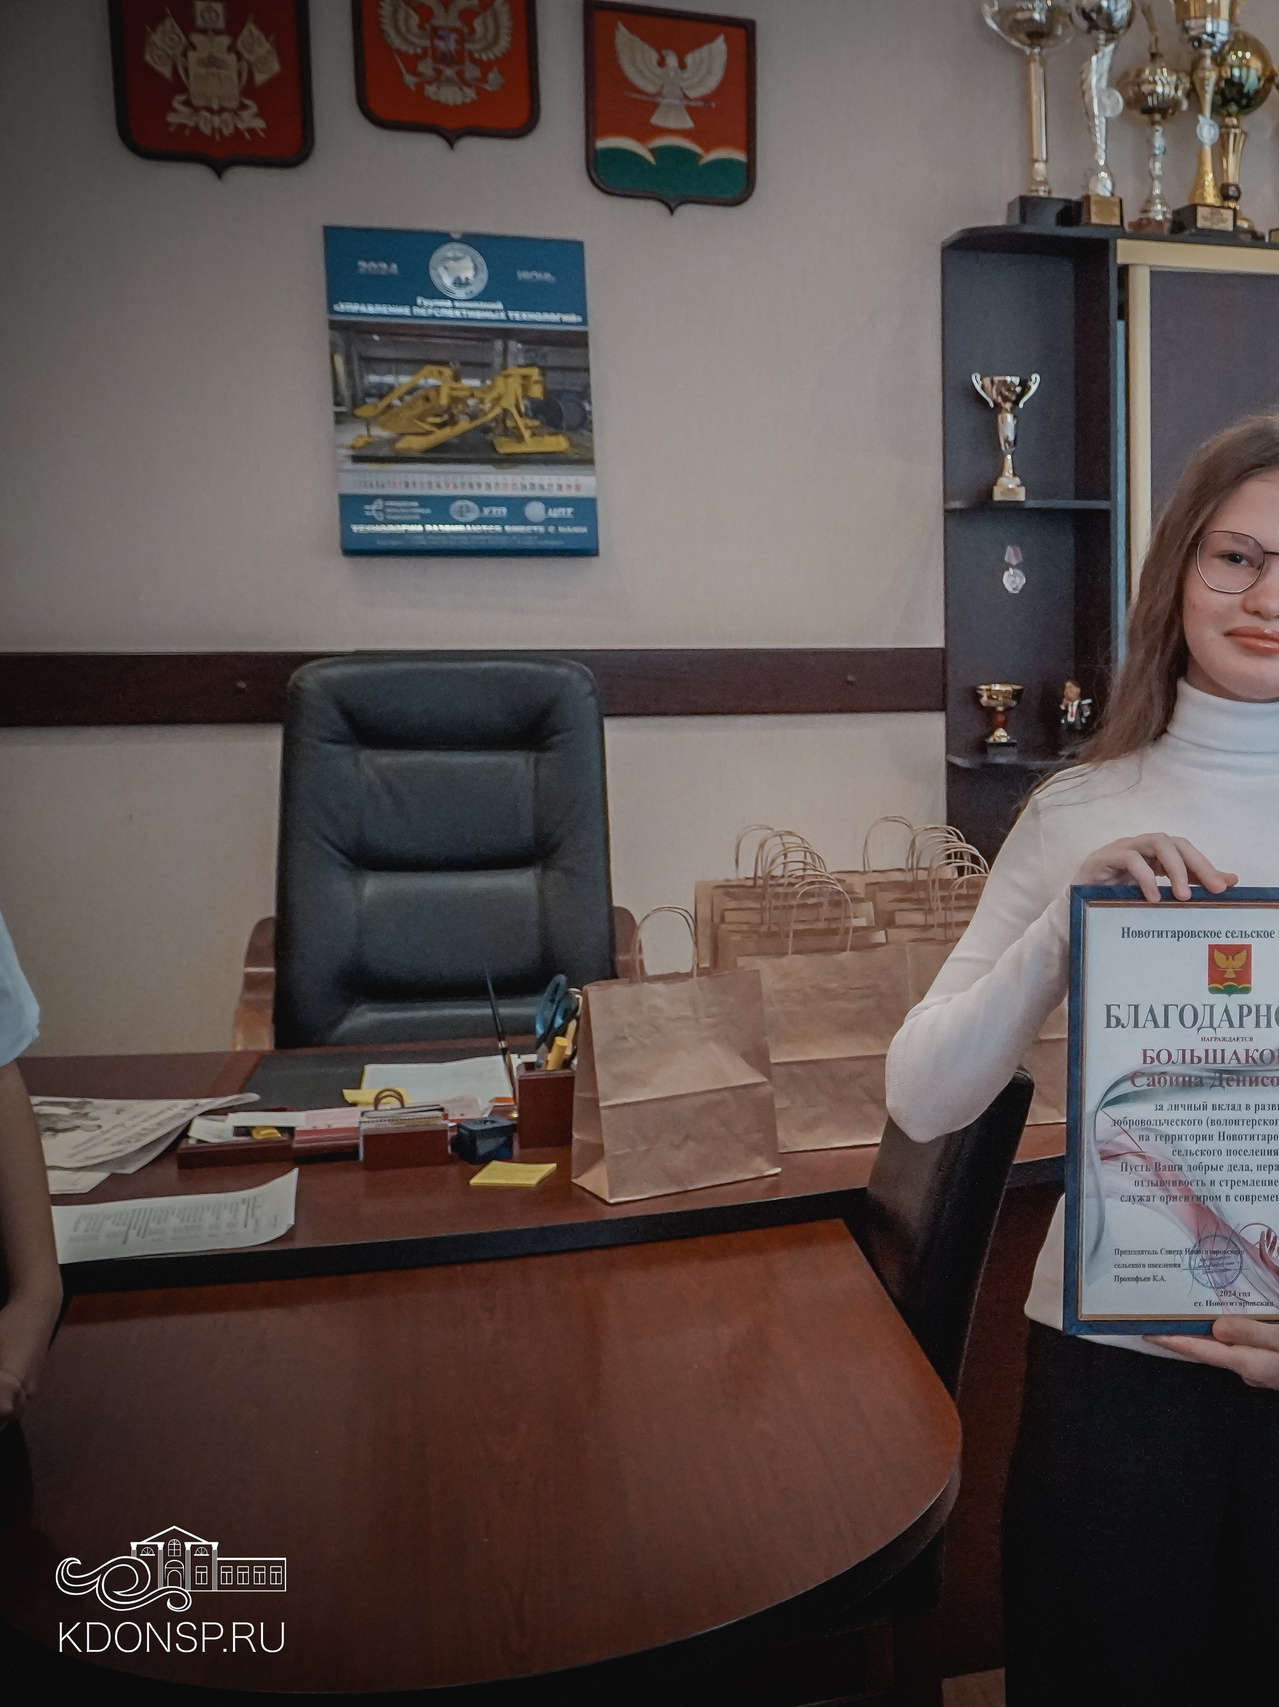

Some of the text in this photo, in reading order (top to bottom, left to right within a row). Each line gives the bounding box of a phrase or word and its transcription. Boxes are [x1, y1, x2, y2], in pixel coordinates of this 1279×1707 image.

[1121, 926, 1221, 941] Новотитаровское
[1225, 928, 1274, 939] сельское
[1130, 1071, 1204, 1088] Сабина
[1154, 1103, 1164, 1111] за
[1167, 1101, 1208, 1112] личный
[1212, 1102, 1242, 1112] вклад
[1245, 1103, 1251, 1111] в
[1111, 1117, 1203, 1129] добровольческого
[1138, 1133, 1150, 1141] на
[1154, 1133, 1214, 1144] территории
[1172, 1147, 1222, 1157] сельского
[1120, 1162, 1150, 1175] Пусть
[1154, 1162, 1183, 1173] Ваши
[1186, 1161, 1224, 1175] добрые
[1227, 1163, 1253, 1174] дела,
[1134, 1178, 1206, 1188] отзывчивость
[1210, 1179, 1216, 1187] и
[1219, 1178, 1279, 1191] стремление
[1120, 1193, 1156, 1205] служат
[1160, 1192, 1222, 1205] ориентиром
[1225, 1193, 1231, 1202] в
[1114, 1248, 1158, 1257] Председатель
[1160, 1248, 1182, 1256] Совета
[1114, 1274, 1151, 1284] Прокофьев
